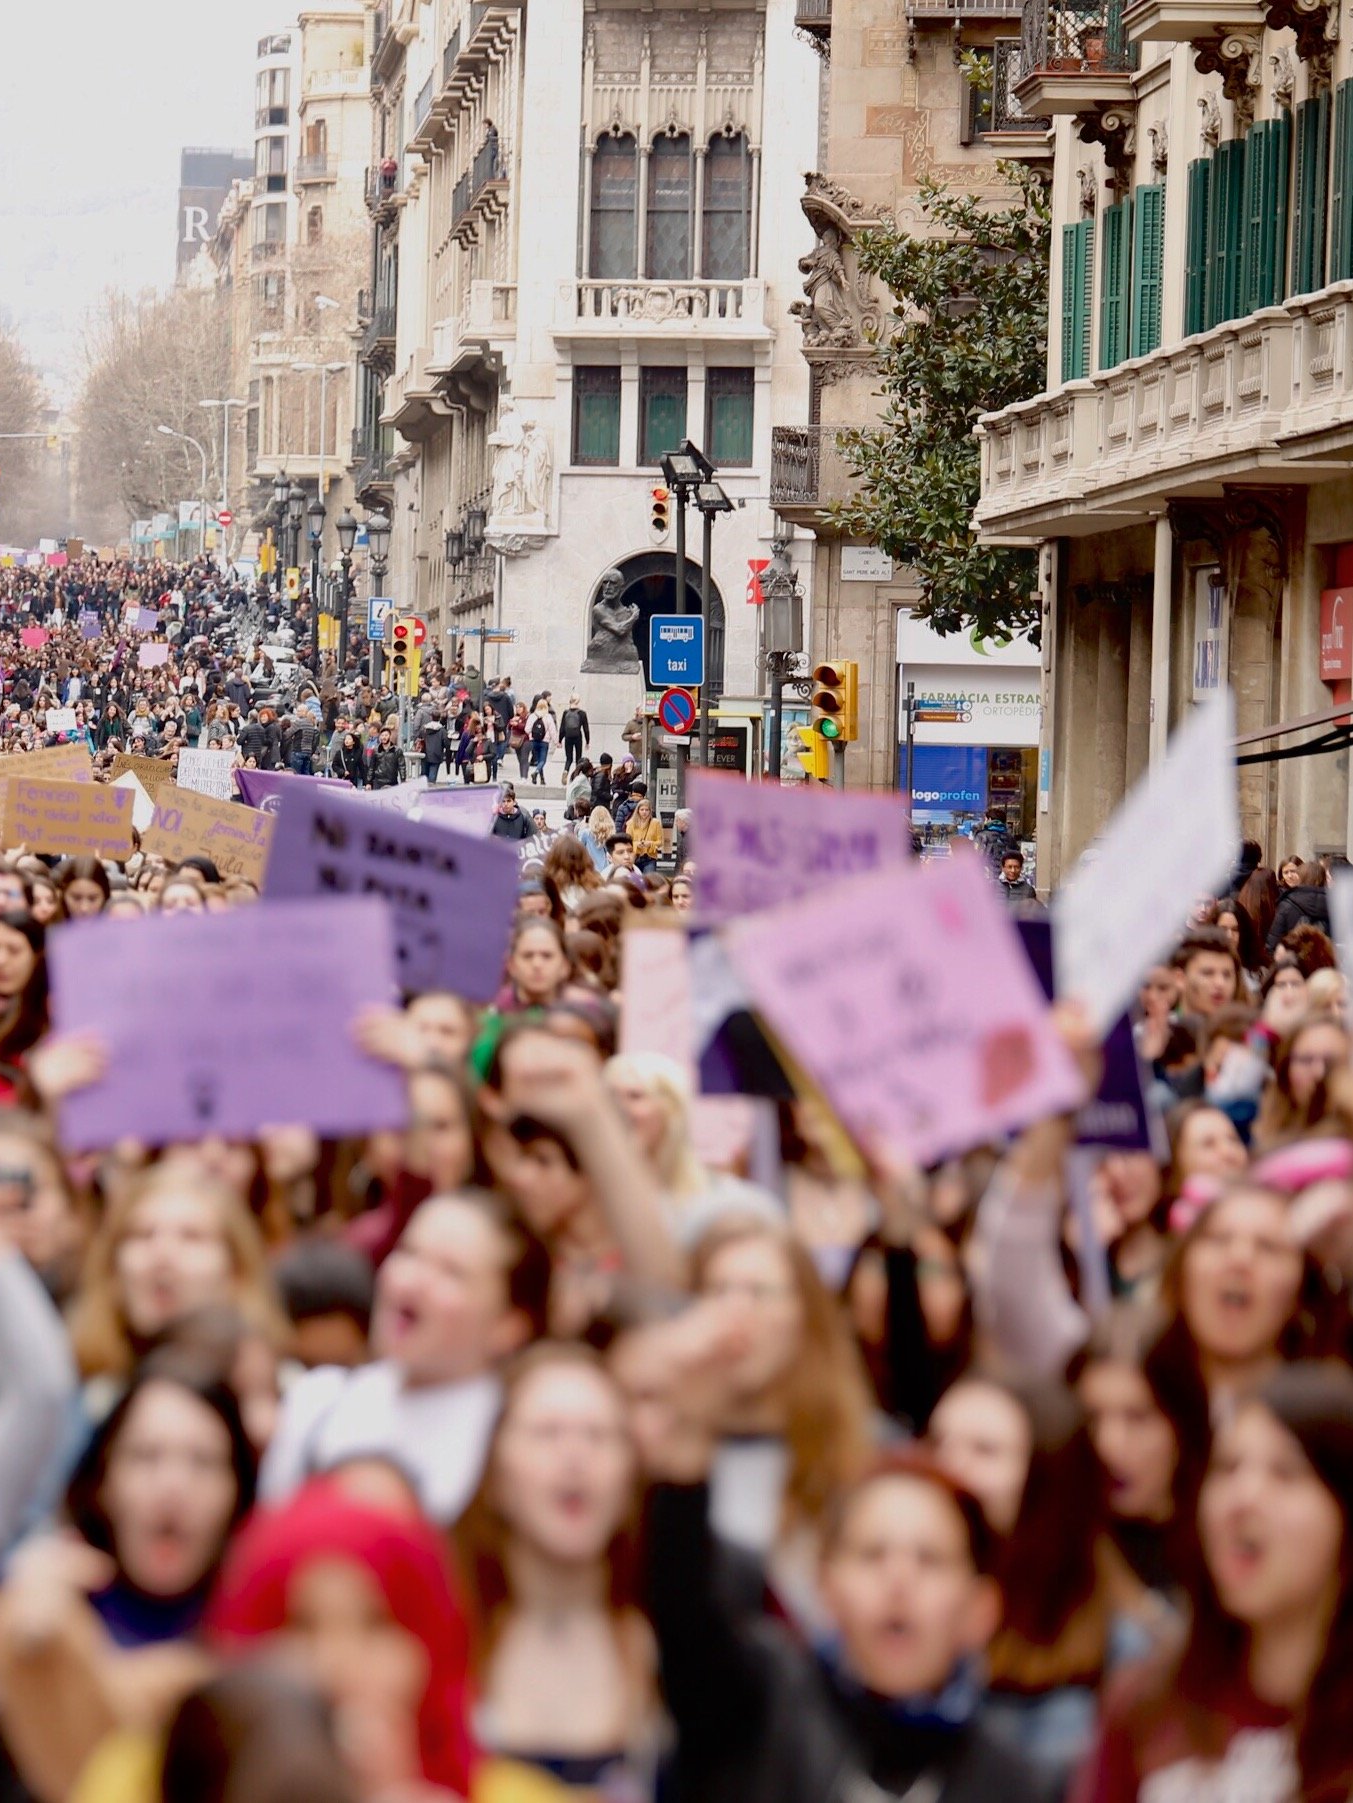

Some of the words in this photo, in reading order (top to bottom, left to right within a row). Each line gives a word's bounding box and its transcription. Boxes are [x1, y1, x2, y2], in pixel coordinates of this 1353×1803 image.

[182, 206, 210, 242] R
[667, 658, 687, 672] taxi
[716, 754, 736, 762] EVER
[17, 780, 80, 804] Feminism
[660, 784, 678, 795] HD
[912, 788, 980, 802] logoprofen
